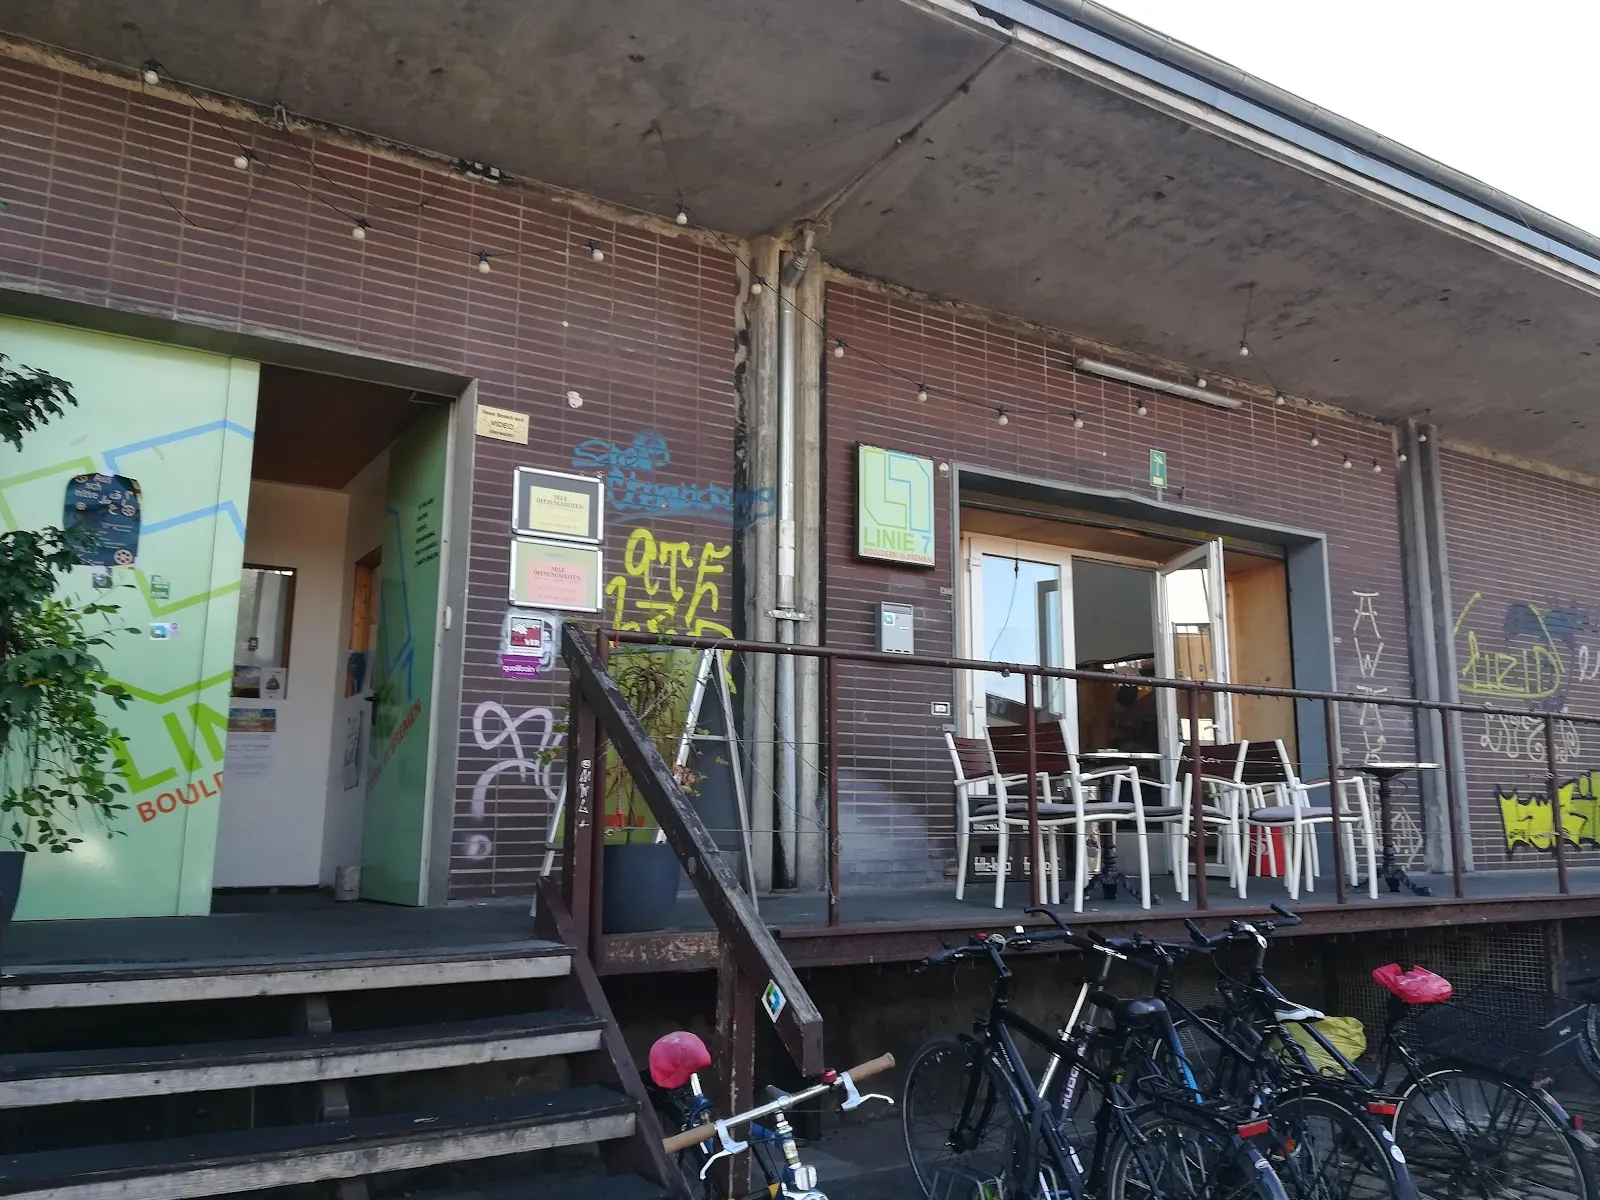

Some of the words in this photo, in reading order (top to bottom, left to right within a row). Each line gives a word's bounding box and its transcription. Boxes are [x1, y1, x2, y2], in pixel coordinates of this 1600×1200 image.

[490, 420, 514, 430] VIDEO
[553, 494, 567, 502] NEUE
[864, 527, 916, 552] LINIE
[921, 536, 931, 553] 7
[863, 548, 898, 559] BOULDERN
[907, 553, 932, 562] BREMEN
[533, 569, 582, 581] ÖFFNUNGSZEITEN:
[502, 664, 536, 674] qualitrain
